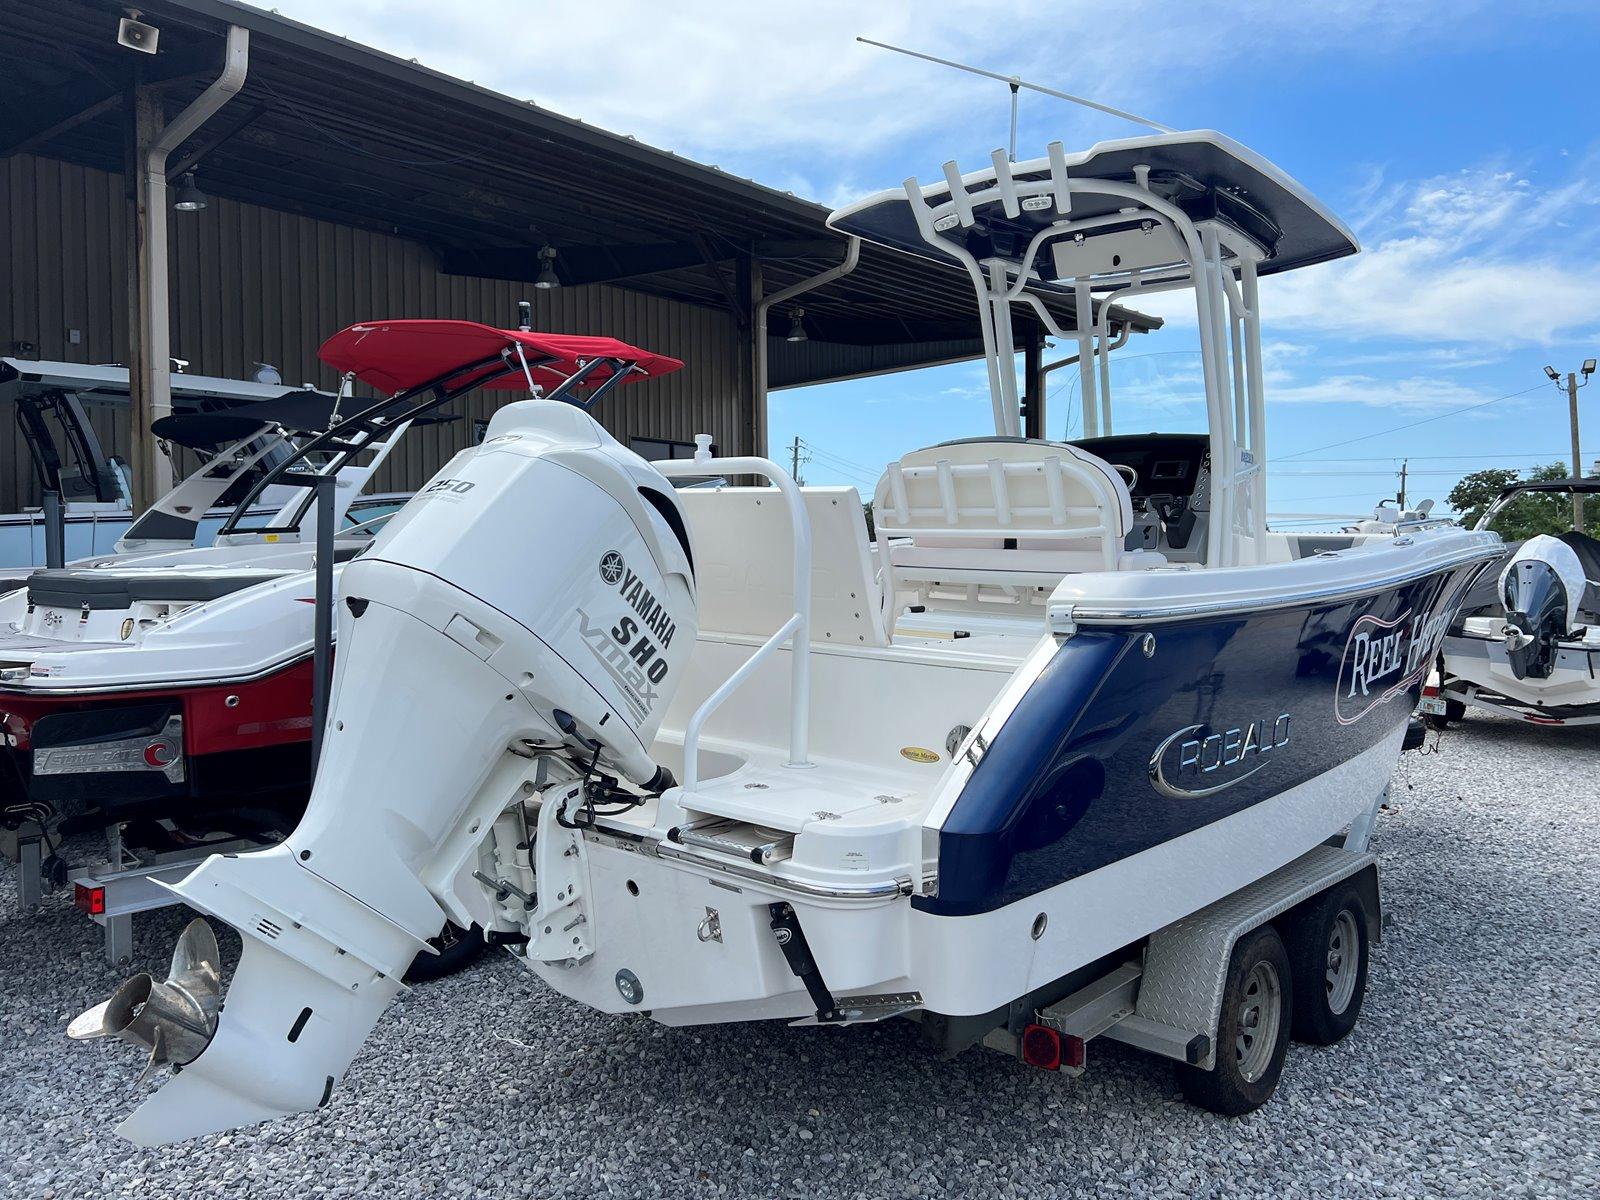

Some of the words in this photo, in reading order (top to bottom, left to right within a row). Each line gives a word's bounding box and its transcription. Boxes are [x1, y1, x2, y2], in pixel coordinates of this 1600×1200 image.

[425, 479, 476, 493] 250
[619, 566, 676, 650] YAMAHA
[611, 616, 668, 684] SHO
[1347, 629, 1403, 698] REEL
[1178, 713, 1290, 776] ROBALO
